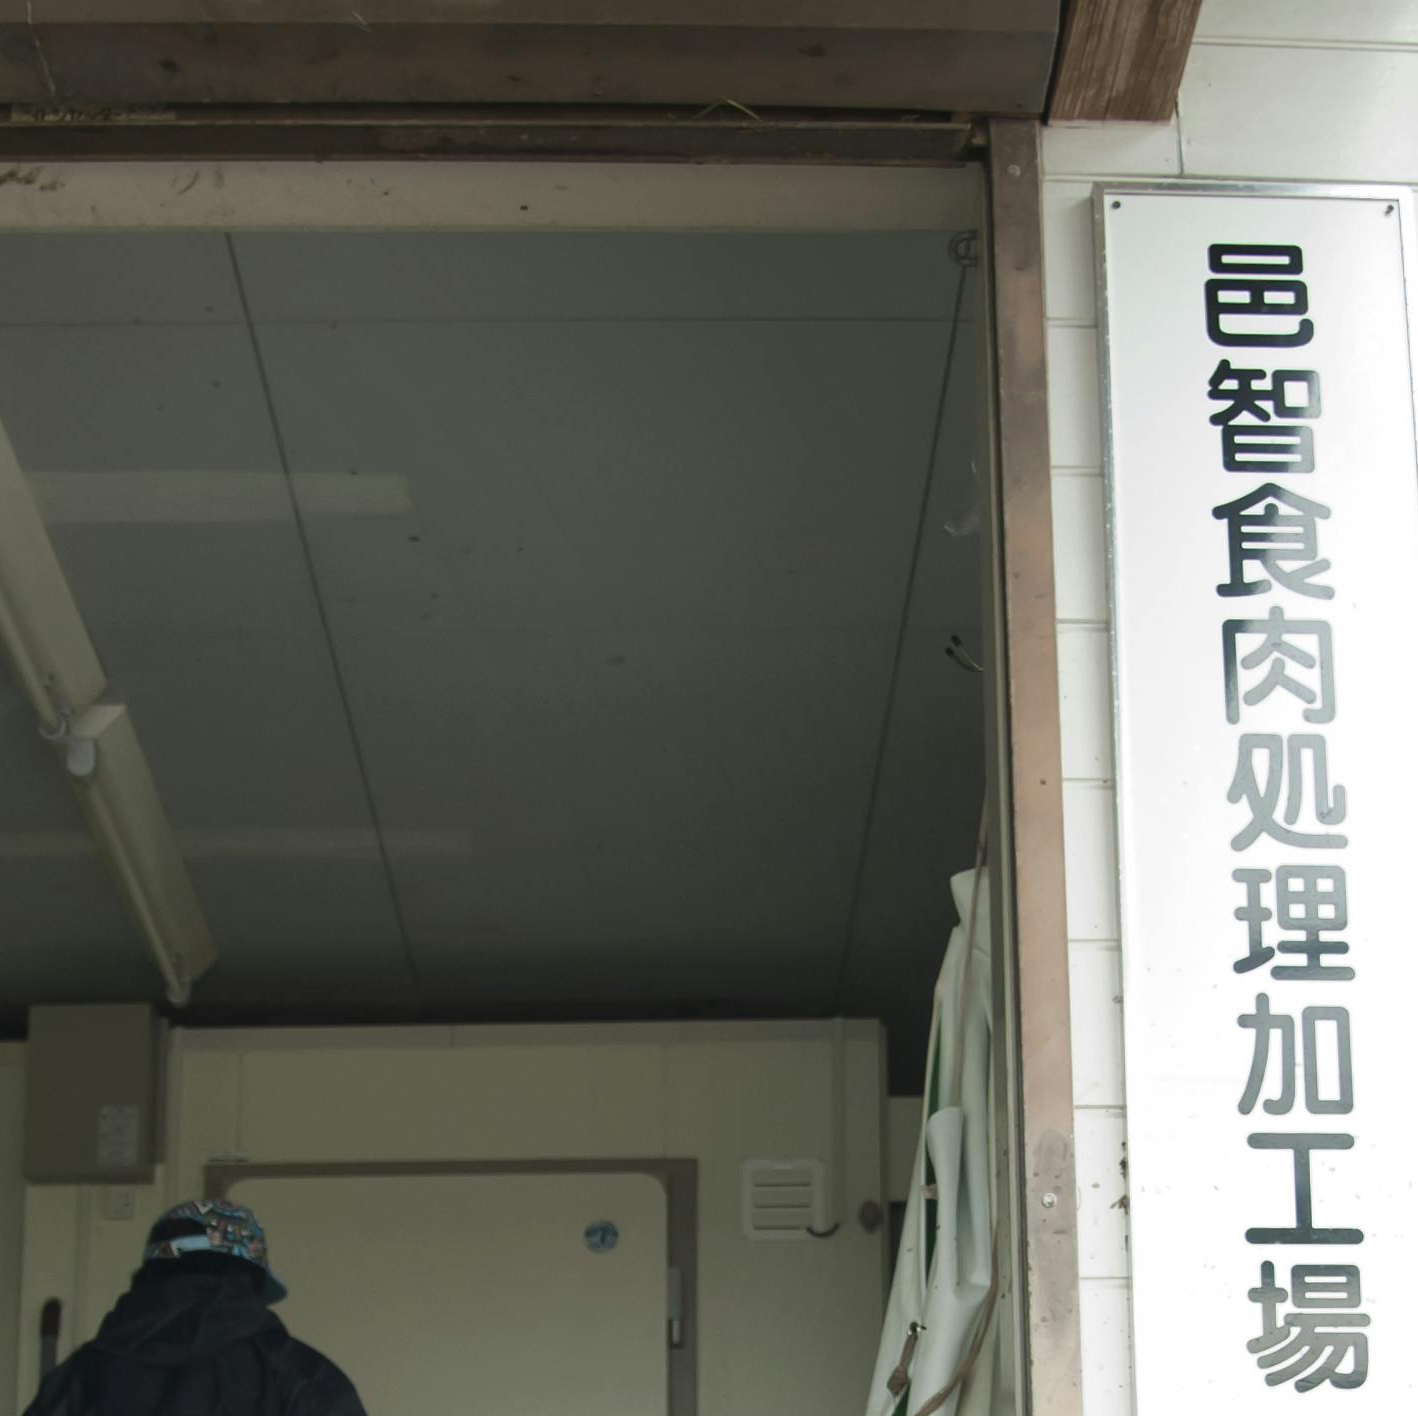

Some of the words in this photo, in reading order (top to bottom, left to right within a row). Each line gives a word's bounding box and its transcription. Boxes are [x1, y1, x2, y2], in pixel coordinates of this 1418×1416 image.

[1203, 242, 1372, 1393] 邑智食肉処理加工場
